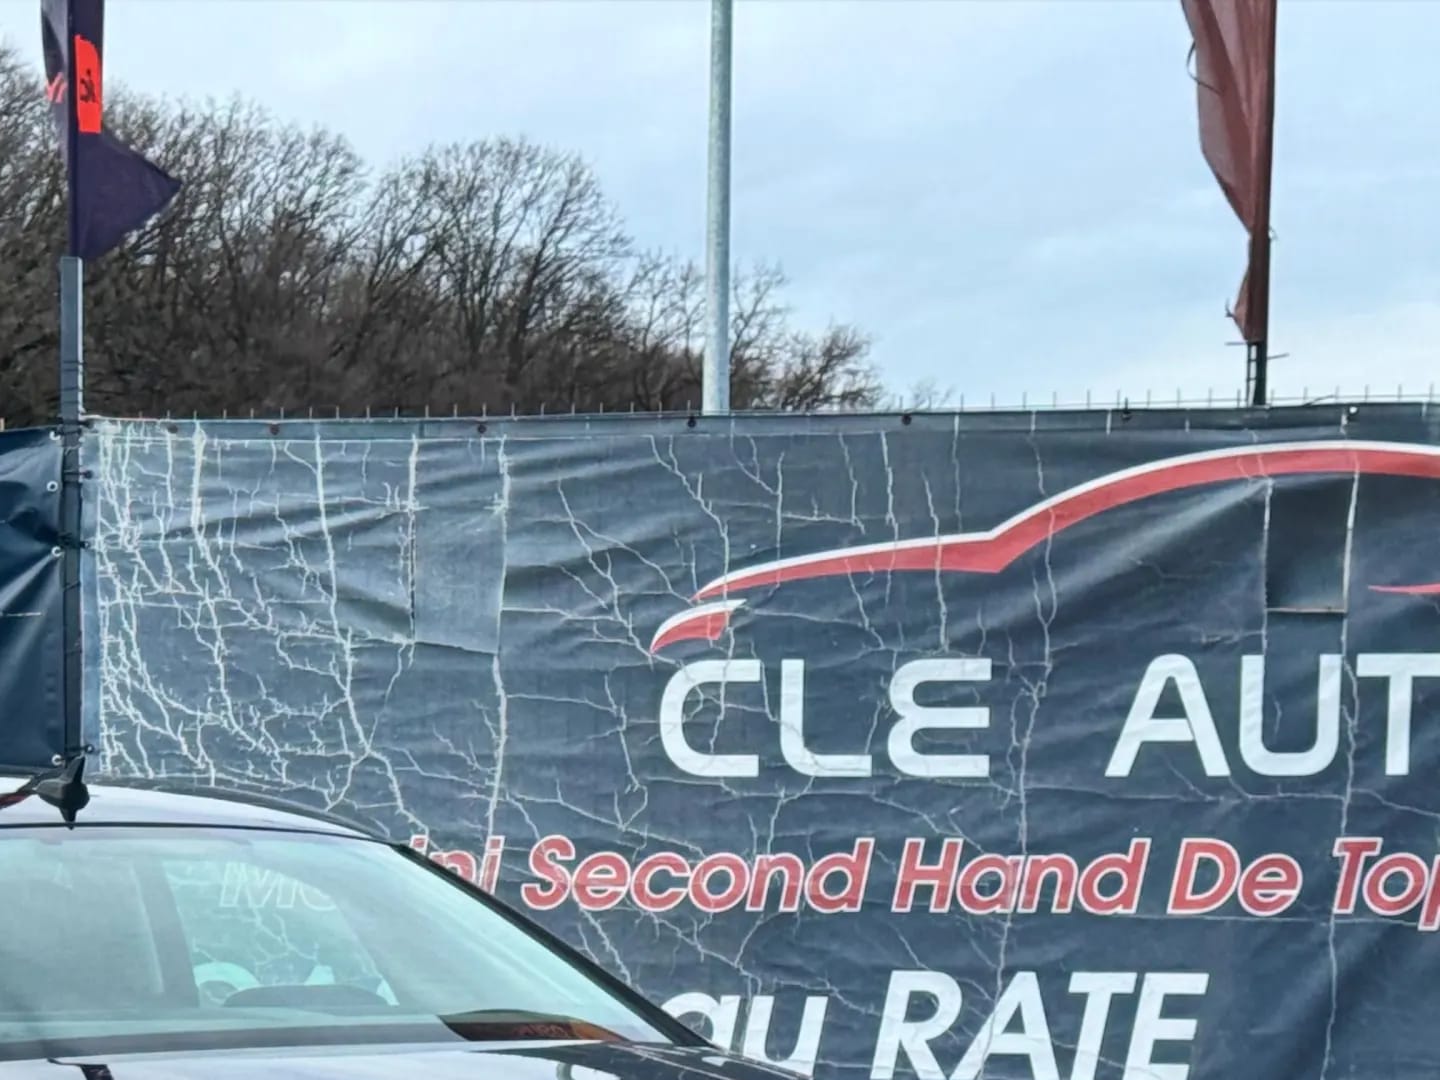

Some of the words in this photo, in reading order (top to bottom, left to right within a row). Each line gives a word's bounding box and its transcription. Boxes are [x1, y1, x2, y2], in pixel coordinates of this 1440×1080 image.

[660, 657, 992, 778] CLE
[1105, 653, 1440, 778] AUT
[520, 834, 876, 914] Second
[892, 837, 1152, 917] Hand
[1166, 836, 1303, 917] De
[660, 992, 829, 1080] au
